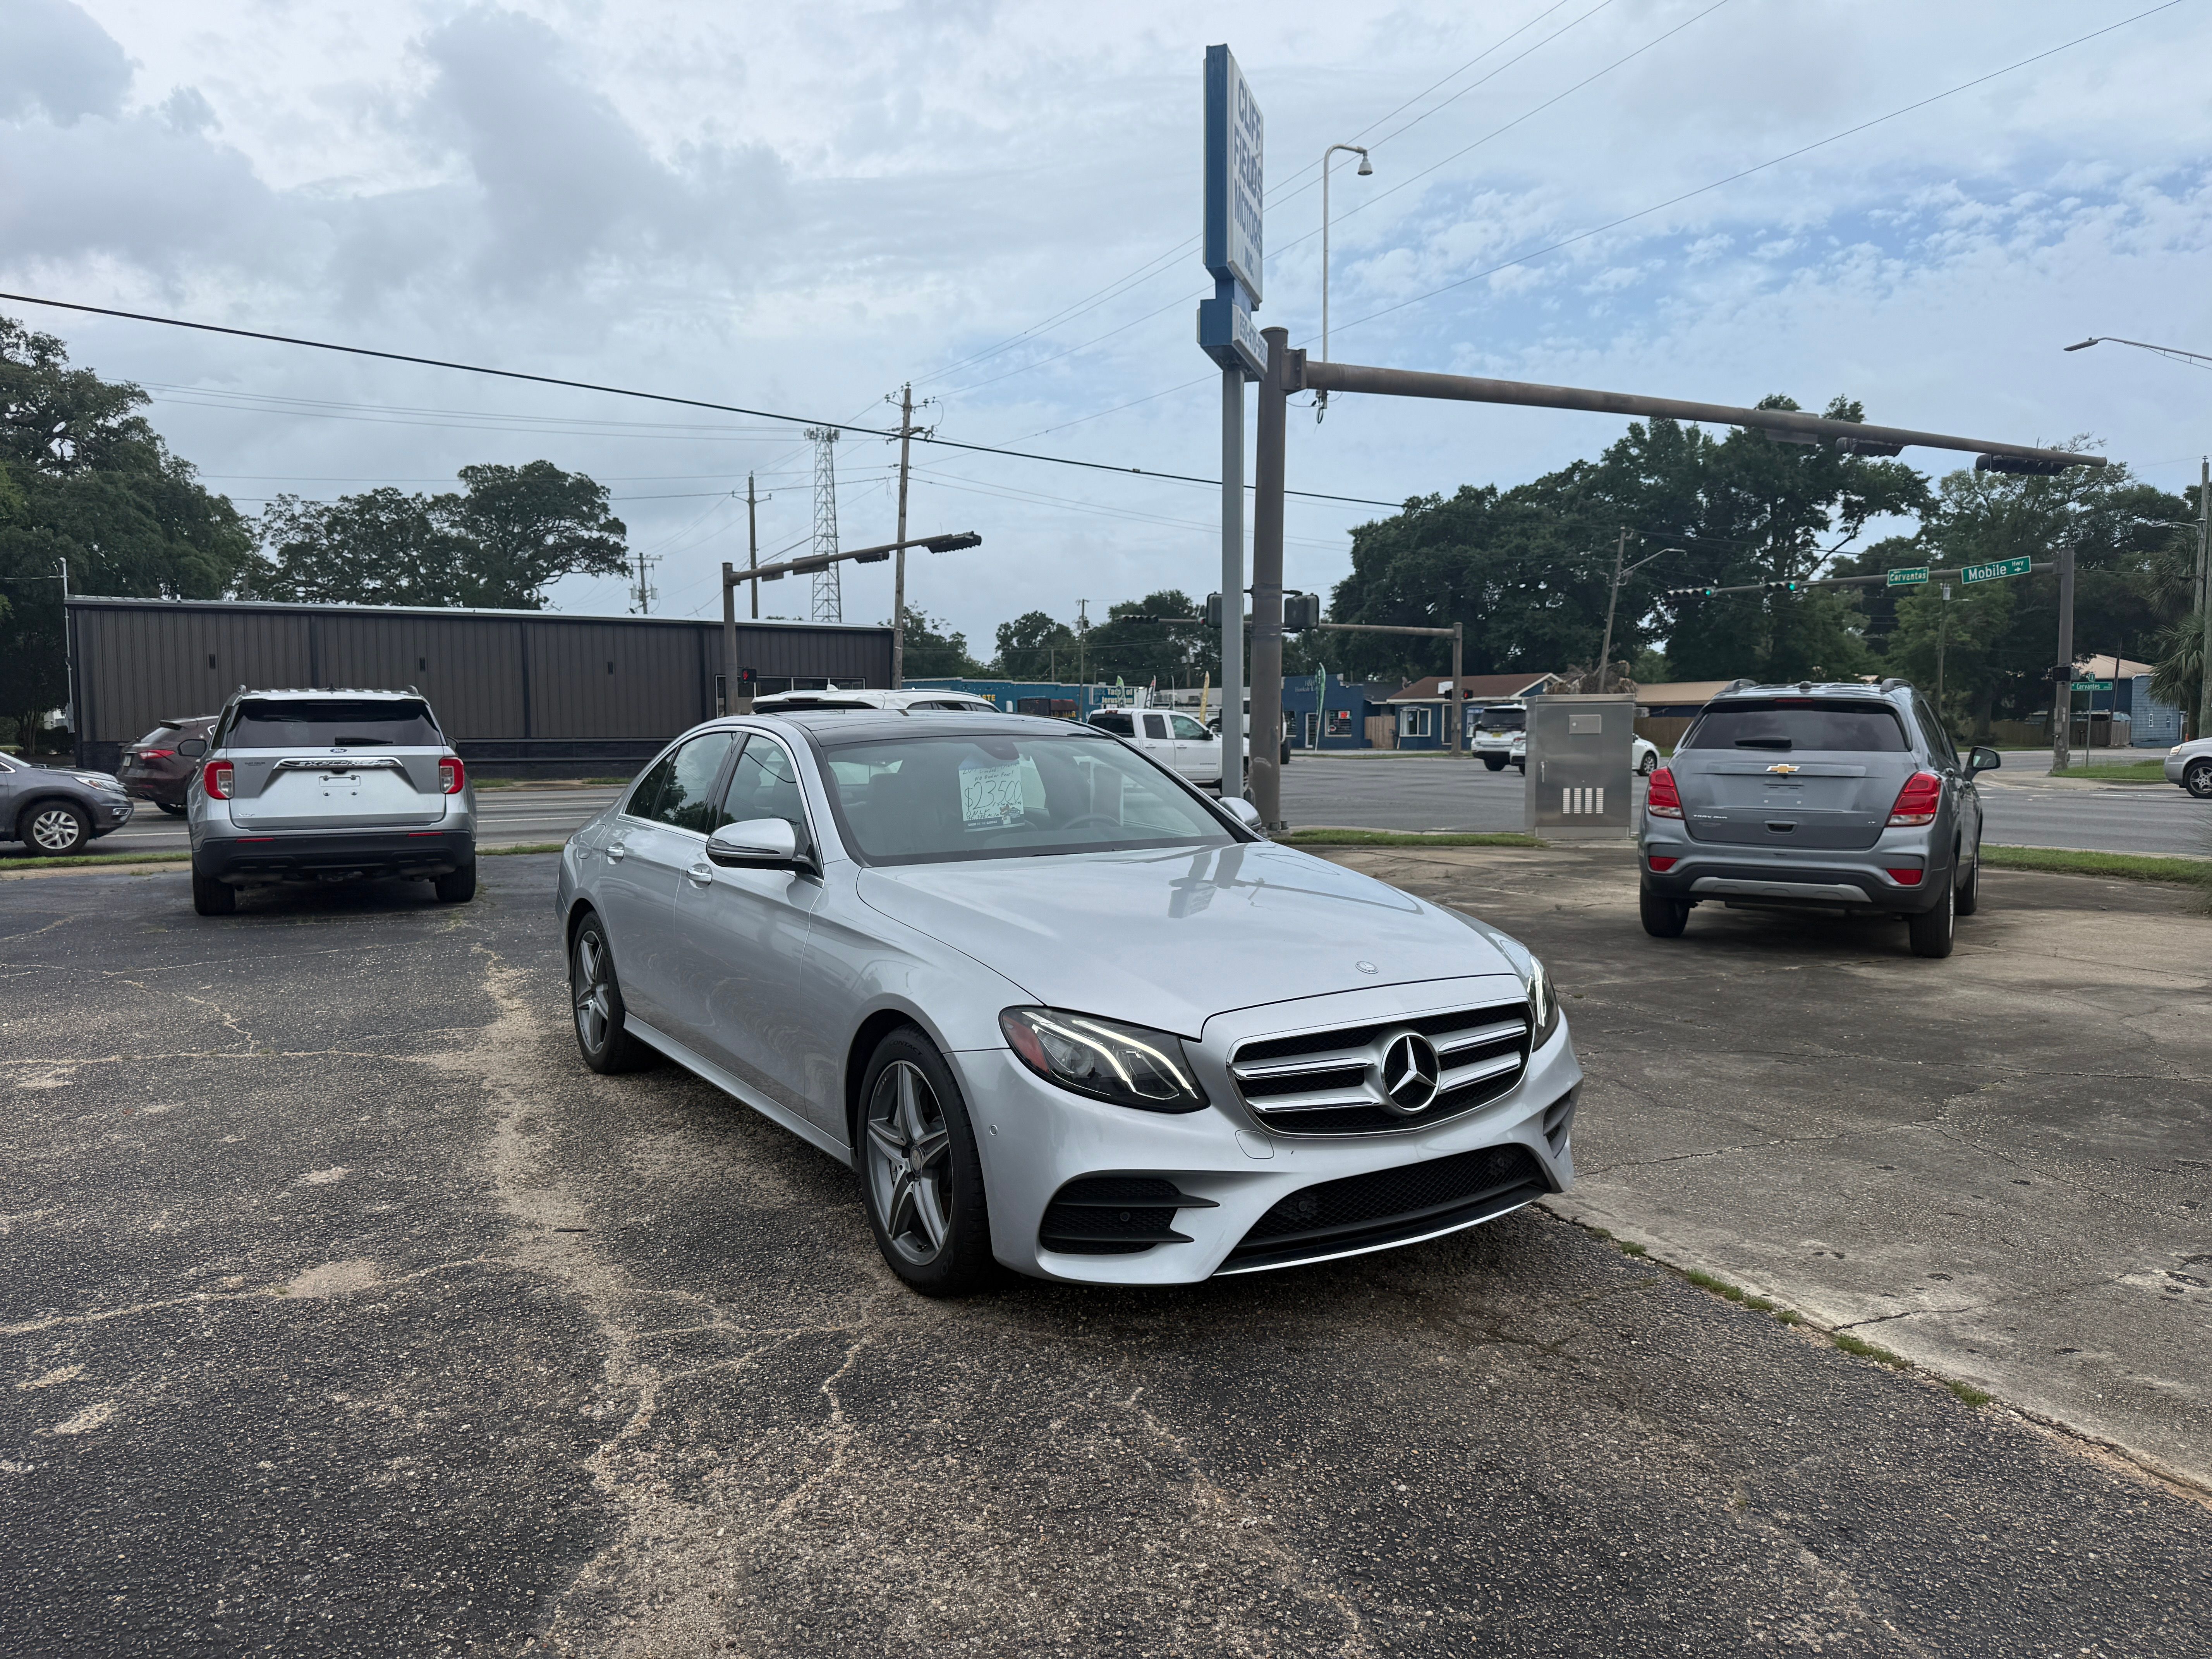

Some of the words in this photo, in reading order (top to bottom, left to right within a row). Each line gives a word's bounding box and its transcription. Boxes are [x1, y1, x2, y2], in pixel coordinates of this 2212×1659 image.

[1238, 77, 1261, 151] CLIFF
[1234, 123, 1263, 209] FIELDS
[1234, 178, 1262, 259] MOTORS
[1968, 564, 2007, 581] Mobile
[888, 1039, 923, 1056] CONTACT
